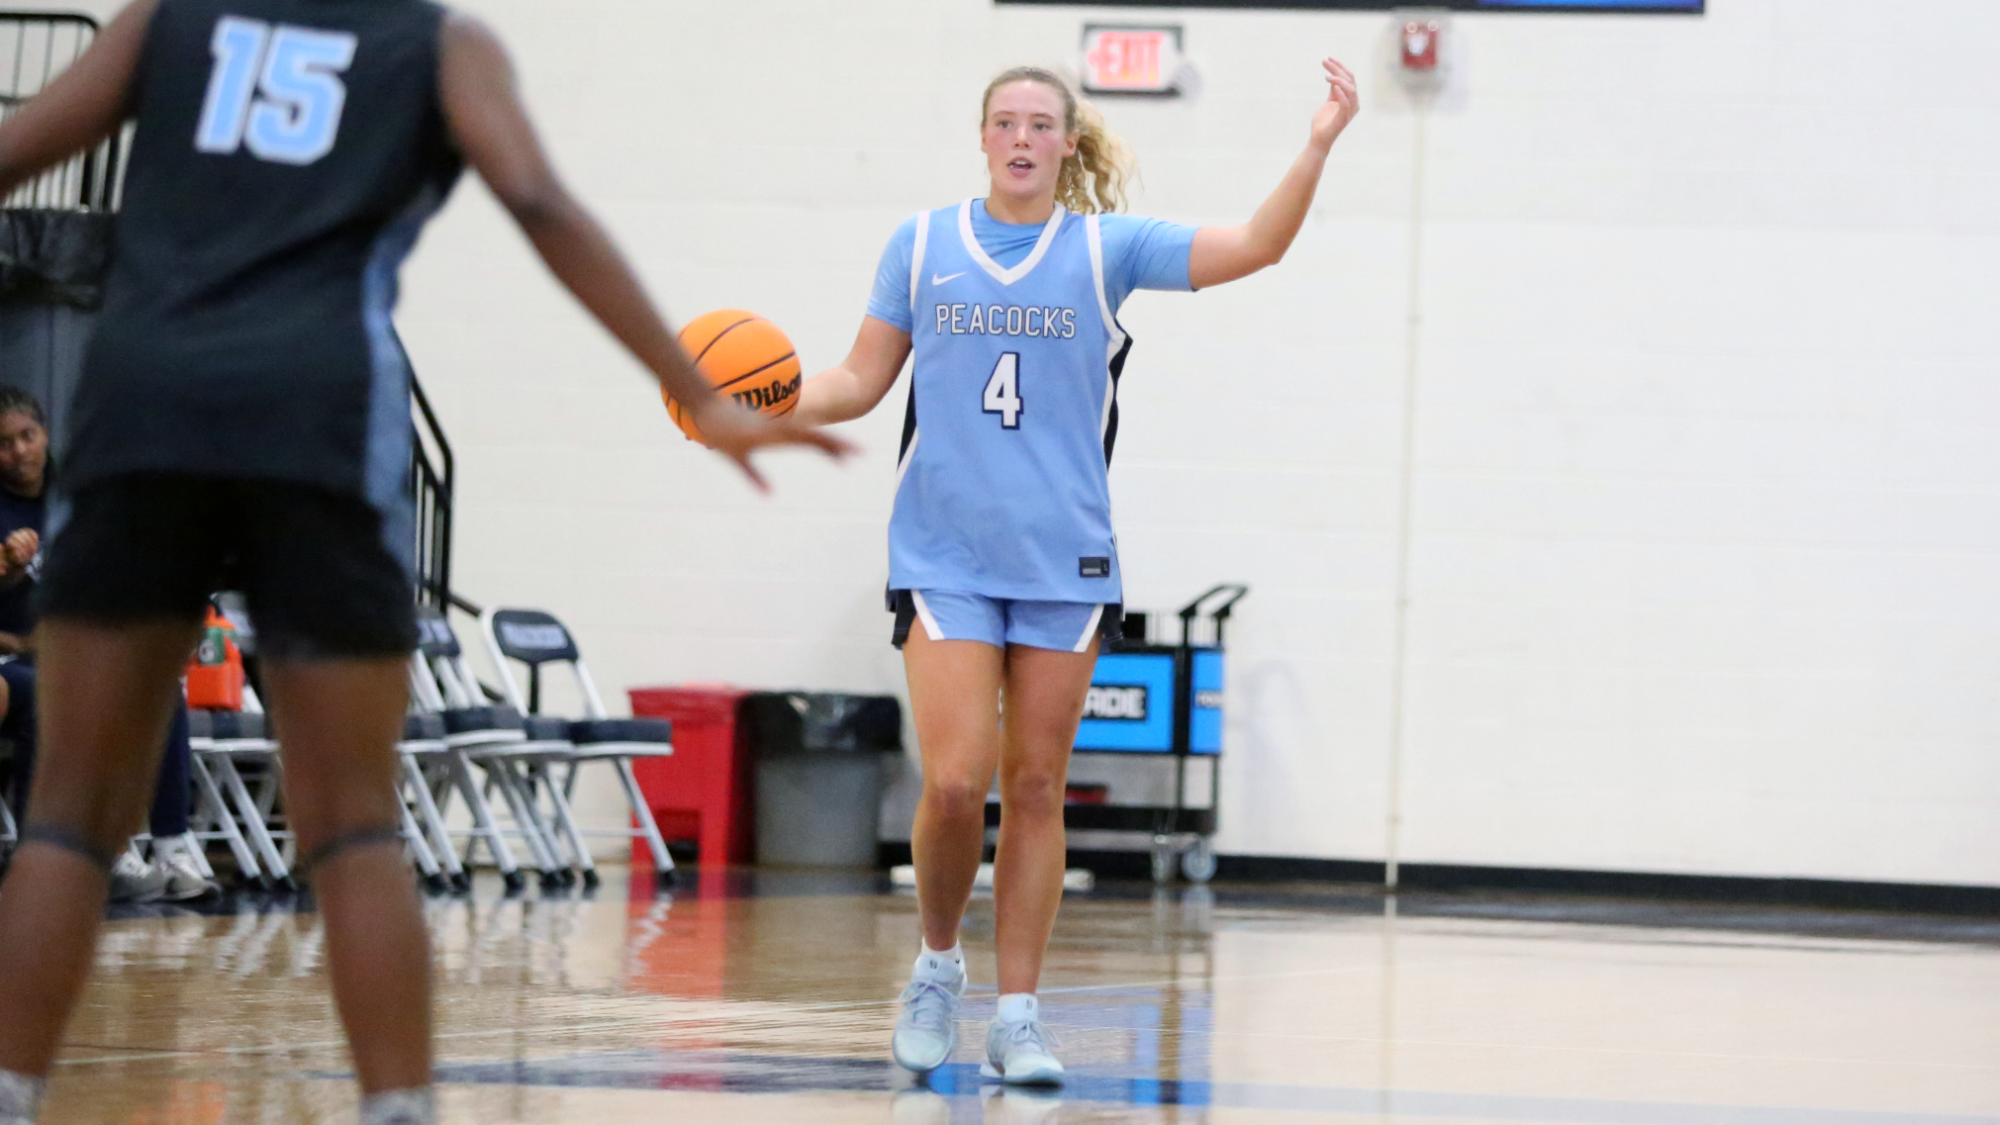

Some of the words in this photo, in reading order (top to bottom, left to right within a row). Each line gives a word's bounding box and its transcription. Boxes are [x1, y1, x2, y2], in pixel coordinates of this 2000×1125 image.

[195, 15, 358, 166] 15
[1097, 31, 1165, 88] EXIT
[935, 303, 1076, 339] PEACOCKS
[982, 351, 1024, 430] 4
